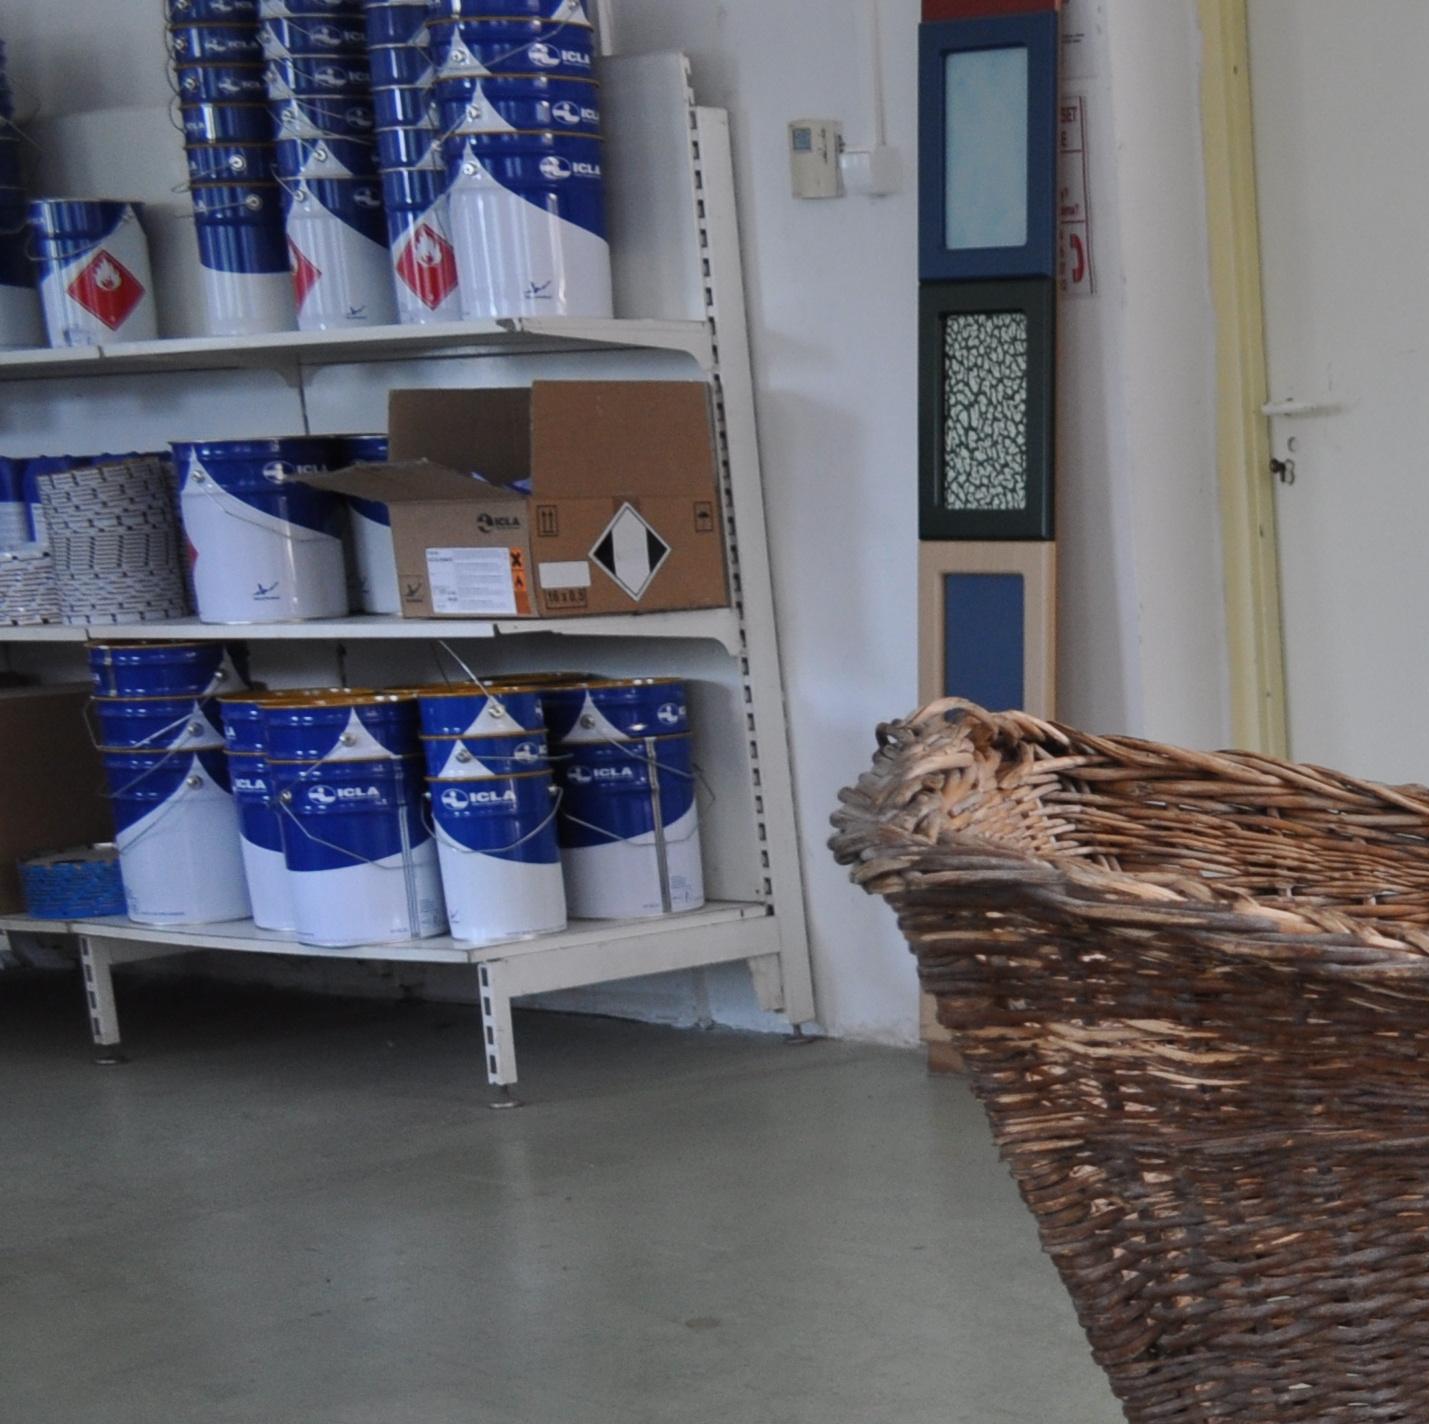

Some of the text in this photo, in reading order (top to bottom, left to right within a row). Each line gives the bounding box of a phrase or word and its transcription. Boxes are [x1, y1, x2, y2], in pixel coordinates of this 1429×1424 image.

[594, 766, 633, 778] ICLA
[337, 786, 380, 798] ICLA
[469, 790, 516, 803] ICLA
